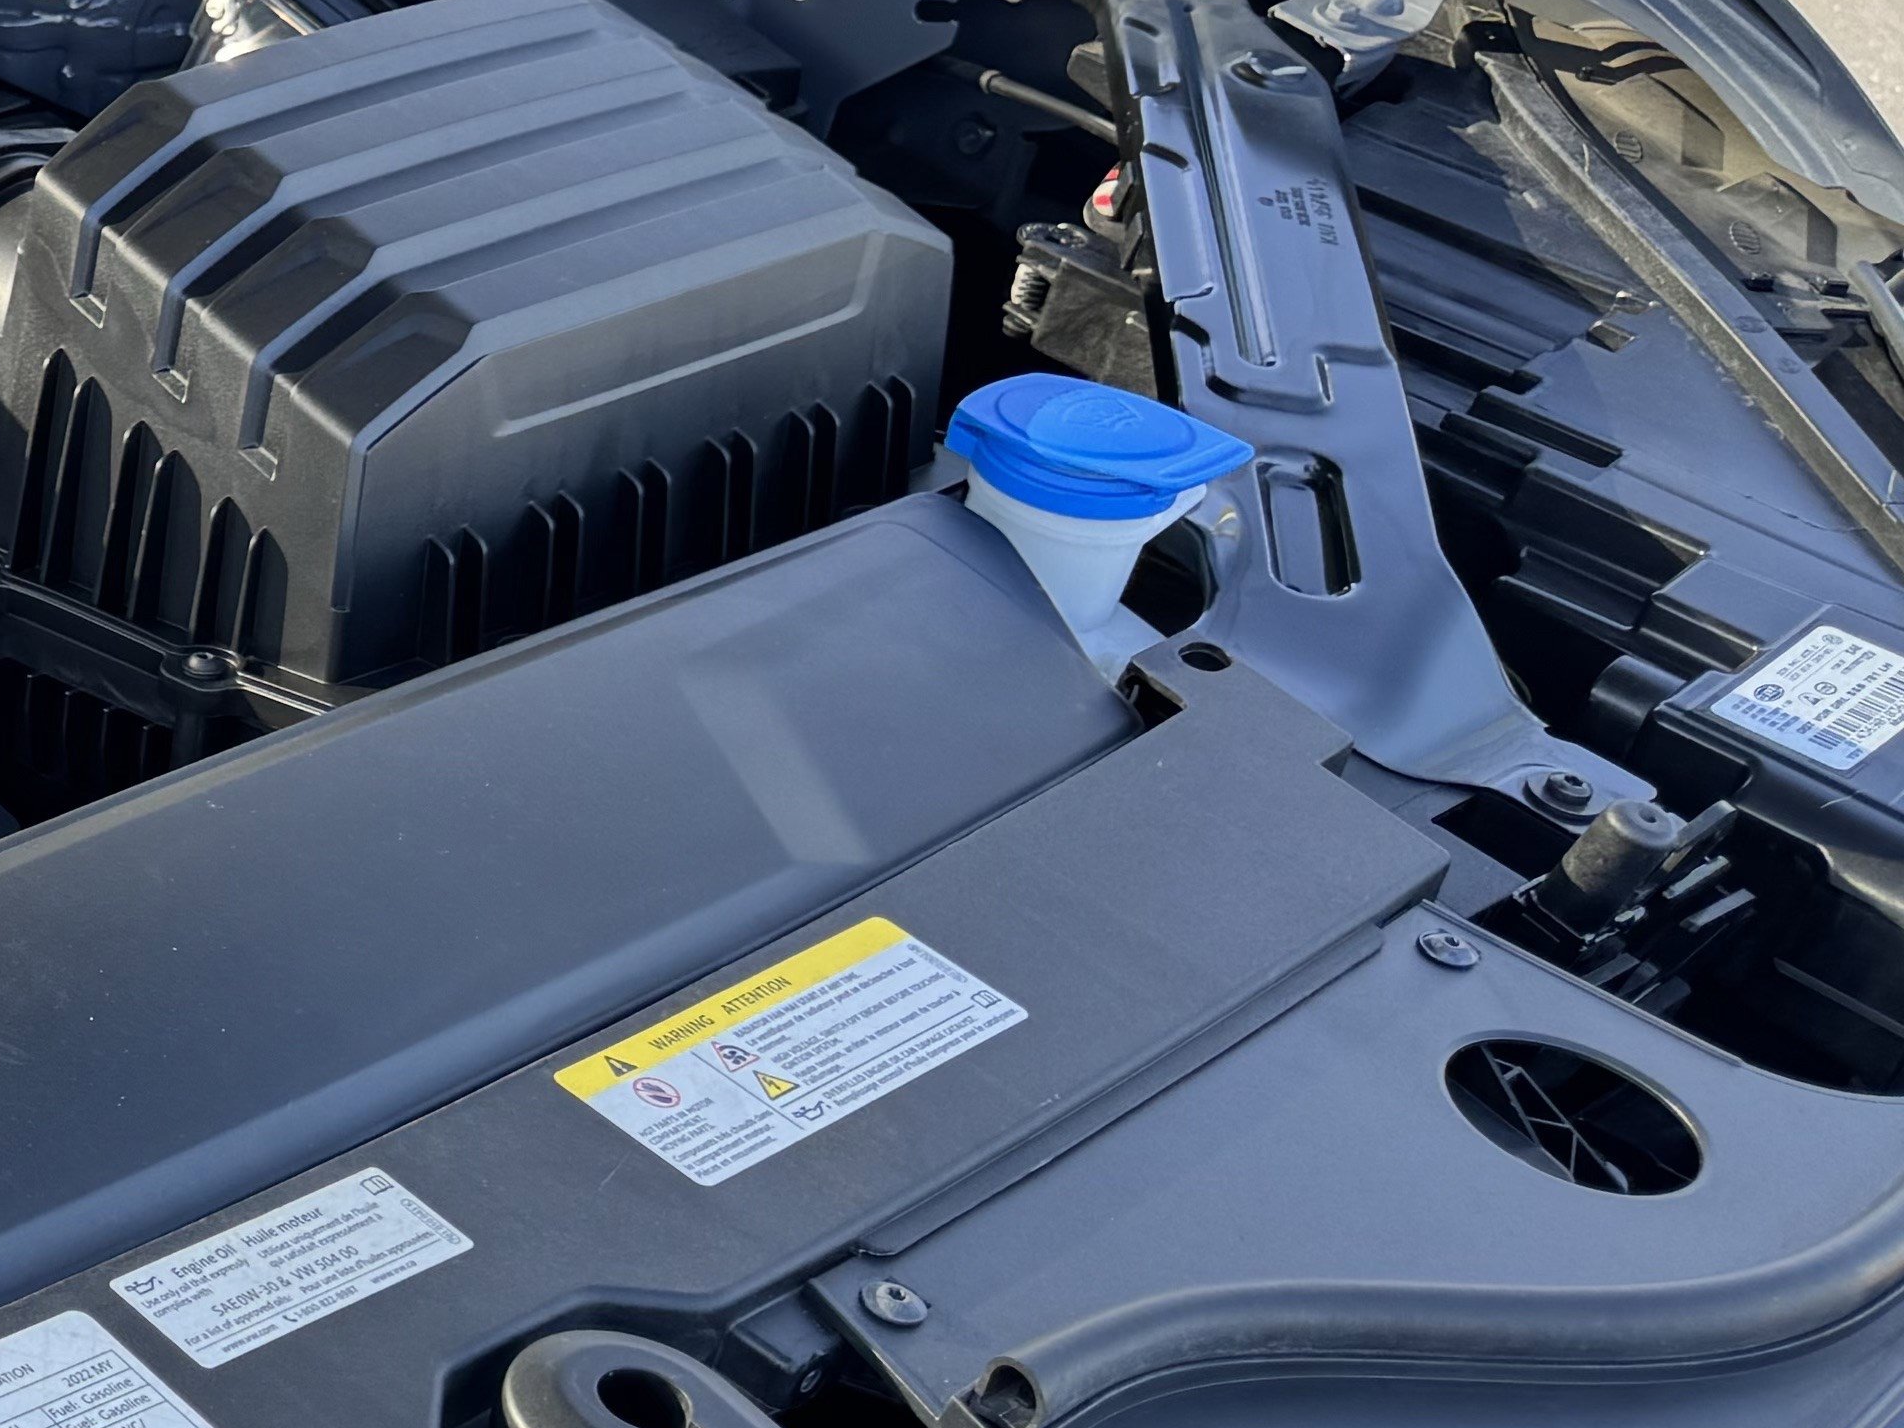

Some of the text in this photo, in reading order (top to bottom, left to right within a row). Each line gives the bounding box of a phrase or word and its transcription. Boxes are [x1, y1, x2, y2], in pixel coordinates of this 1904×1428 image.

[649, 977, 790, 1049] WARNING ATTENTION
[339, 1213, 353, 1221] de
[171, 1208, 324, 1279] Engine Oil Huile moteur
[268, 1258, 286, 1268] qui
[141, 1297, 161, 1308] Use
[157, 1288, 182, 1302] only
[177, 1283, 191, 1291] oil
[189, 1275, 210, 1286] that
[212, 1245, 359, 1315] SAE0W-30 & VW 504 00
[152, 1287, 212, 1318] complies with
[183, 1335, 202, 1345] For
[205, 1325, 223, 1335] list
[220, 1320, 234, 1328] of
[61, 1369, 94, 1386] 2022
[90, 1360, 115, 1374] MY
[48, 1400, 80, 1418] Fuel:
[81, 1377, 133, 1404] Gasoline
[98, 1393, 150, 1419] Gasoline
